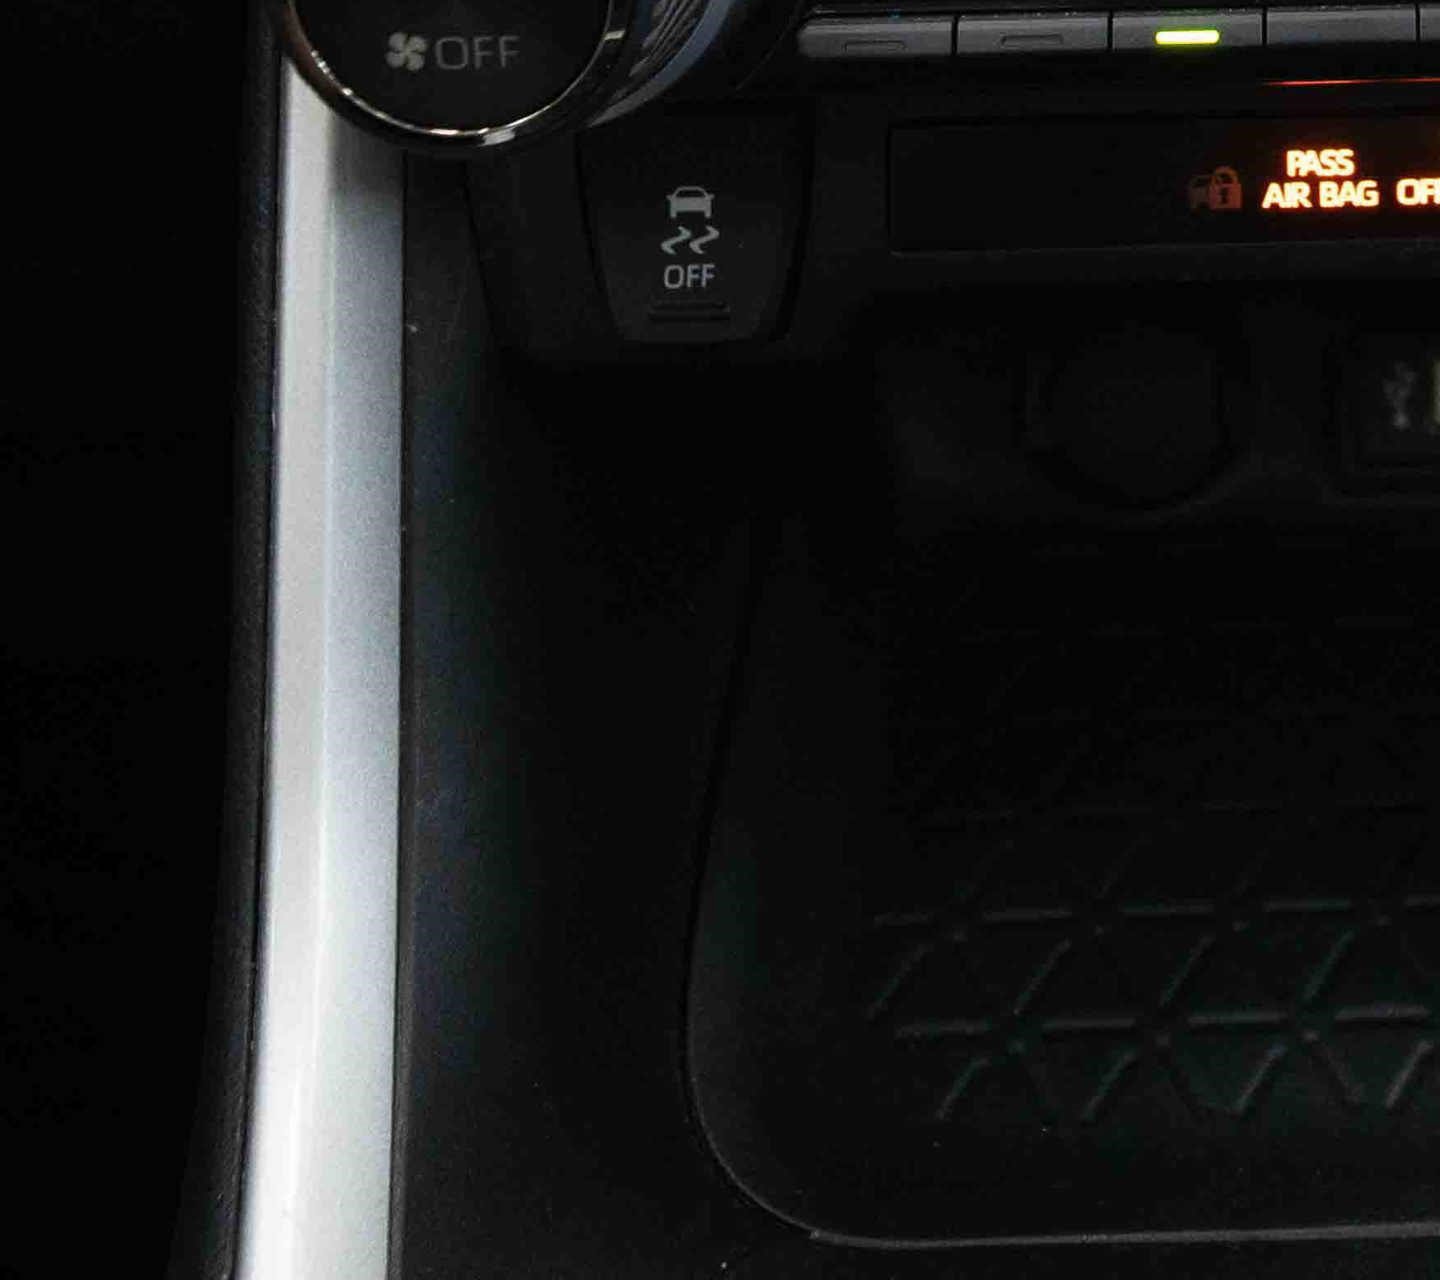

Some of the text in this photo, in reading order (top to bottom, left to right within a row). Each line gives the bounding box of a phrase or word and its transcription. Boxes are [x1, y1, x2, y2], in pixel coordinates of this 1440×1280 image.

[434, 35, 520, 72] OFF
[1285, 148, 1356, 178] PASS
[1261, 180, 1313, 210] AIR
[1318, 180, 1380, 210] BAG
[663, 263, 716, 290] OFF
